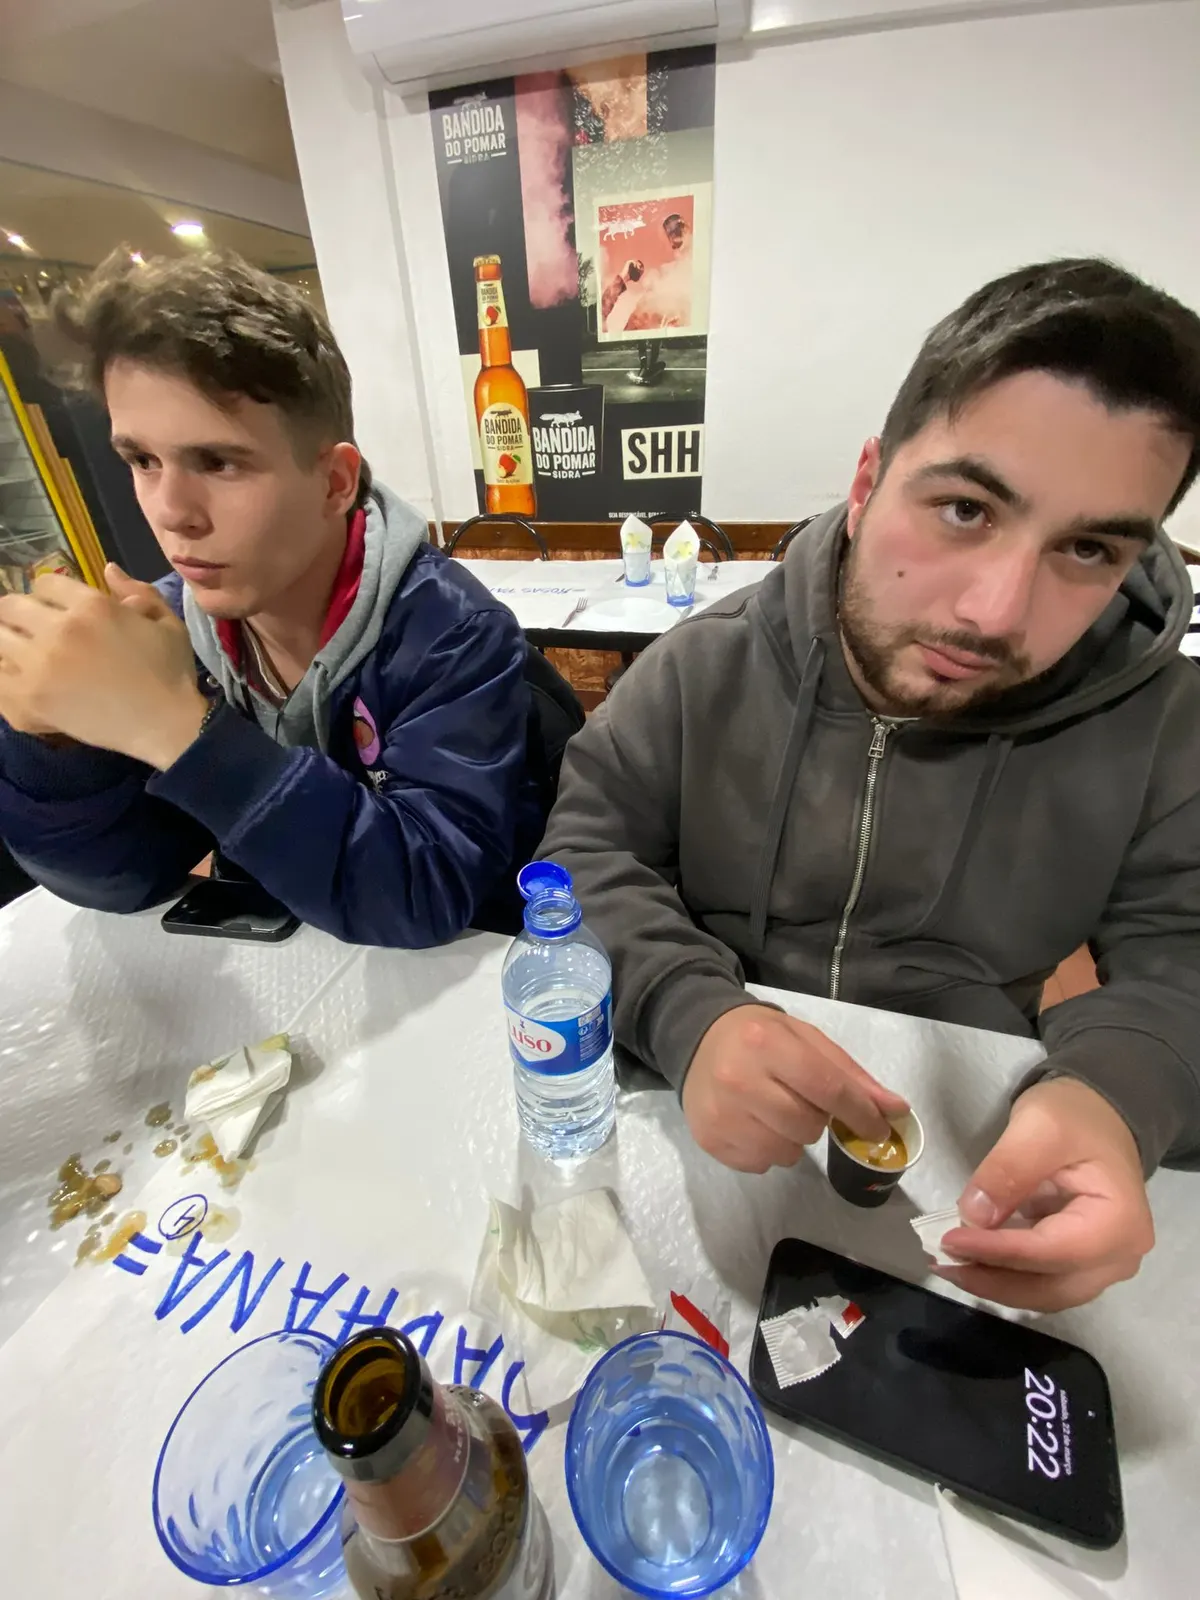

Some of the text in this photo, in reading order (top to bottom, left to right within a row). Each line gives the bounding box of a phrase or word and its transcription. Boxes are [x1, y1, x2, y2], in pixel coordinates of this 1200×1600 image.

[442, 105, 505, 140] BANDIDA
[445, 133, 506, 157] DO POMAR
[484, 418, 522, 435] BANDIDA
[486, 434, 523, 445] DO POMAR
[532, 425, 596, 454] BANDIDA
[535, 452, 596, 471] DO POMAR
[628, 430, 700, 474] SHH
[552, 470, 581, 479] SIDRA
[1024, 1367, 1061, 1479] 20:22
[1063, 1422, 1070, 1434] 22
[1064, 1434, 1070, 1446] de
